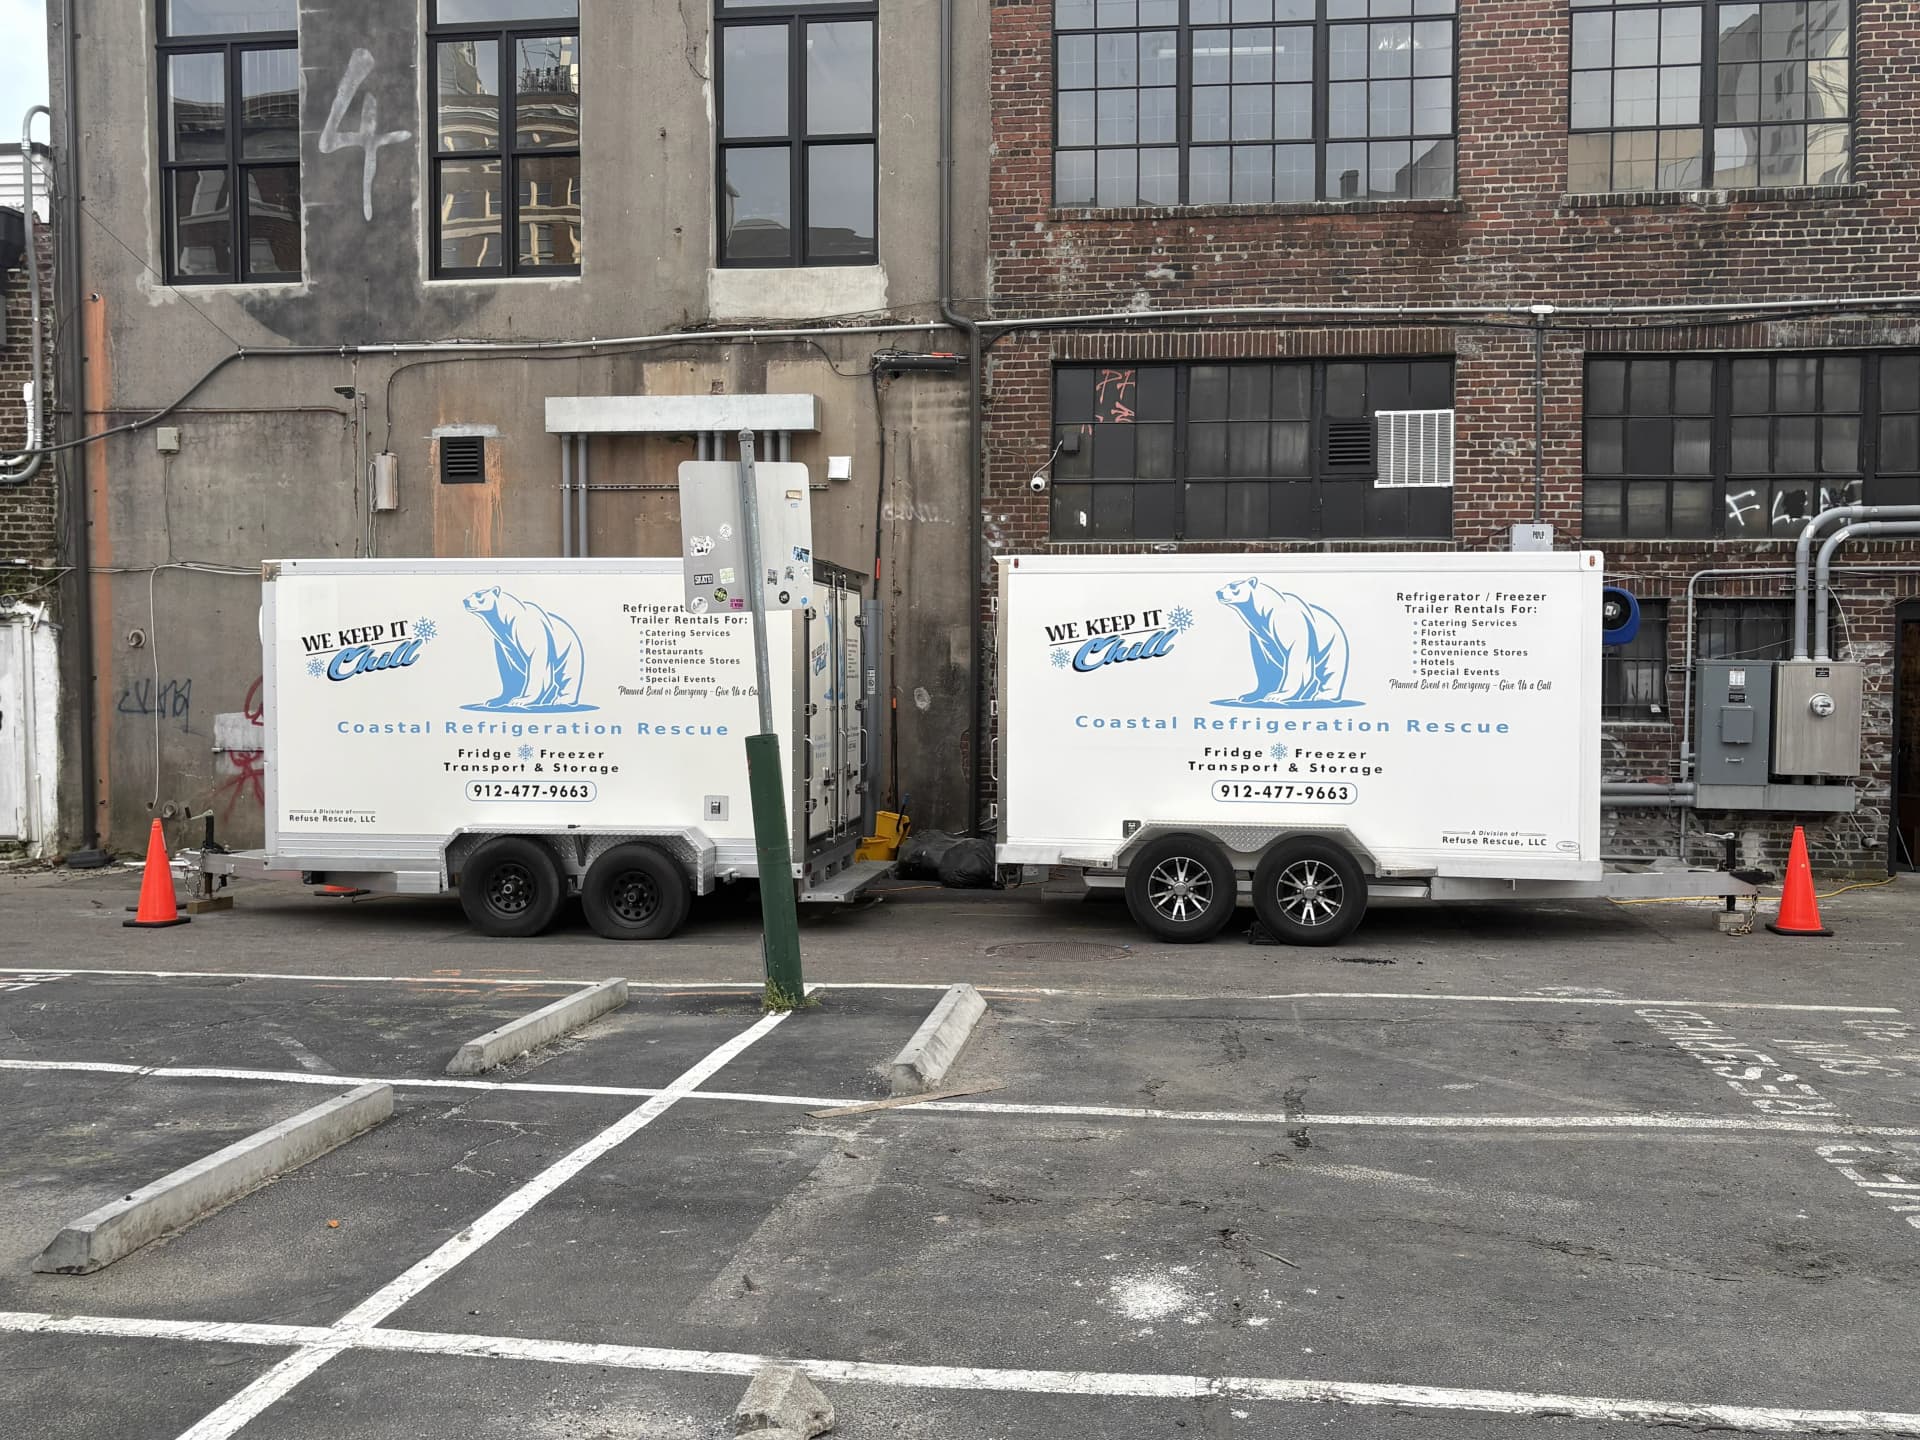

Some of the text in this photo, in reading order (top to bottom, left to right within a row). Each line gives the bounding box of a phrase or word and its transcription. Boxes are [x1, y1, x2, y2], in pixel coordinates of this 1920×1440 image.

[319, 48, 412, 221] 4
[1397, 592, 1547, 603] Refrigerator / Freezer
[623, 603, 686, 614] Refrigerat
[1404, 604, 1536, 613] Trailer Rentals For:
[630, 616, 747, 624] Trailer Rentals For:
[1045, 609, 1164, 642] WE KEEP IT
[1421, 619, 1517, 629] Catering Services
[301, 620, 410, 653] WE KEEP IT
[645, 629, 685, 639] Catering
[1421, 639, 1486, 647] Restaurants
[1072, 628, 1177, 672] Chill
[1421, 648, 1488, 656] Convenience
[327, 640, 421, 681] Chill
[645, 657, 705, 665] Convenience
[1421, 658, 1454, 666] Hotels
[1421, 668, 1499, 677] Special Events
[646, 675, 679, 684] Special
[1389, 679, 1418, 689] Planned
[1421, 679, 1440, 690] Event
[1452, 679, 1490, 692] Emergency
[1499, 679, 1514, 691] Give
[1518, 680, 1527, 691] Us
[1537, 680, 1552, 691] Call
[618, 686, 644, 697] Planned
[646, 686, 664, 696] Event
[665, 688, 672, 696] or
[674, 686, 707, 698] Emergency
[716, 686, 729, 696] Give
[731, 685, 741, 696] Us
[749, 685, 760, 696] Ca
[338, 721, 727, 736] Coastal Refrigeration Rescue
[1076, 716, 1509, 733] Coastal Refrigeration Rescue
[458, 748, 604, 760] Fridge Freezer
[1205, 747, 1366, 760] Fridge Freezer
[443, 762, 619, 775] Transport & Storage
[1188, 760, 1382, 776] Transport & Storage
[474, 784, 588, 798] 912-477-9663
[1221, 784, 1349, 801] 912-477-9663
[289, 814, 319, 823] Refuse
[323, 815, 356, 823] Rescue,
[1442, 835, 1548, 847] Refuse Rescue, LLC
